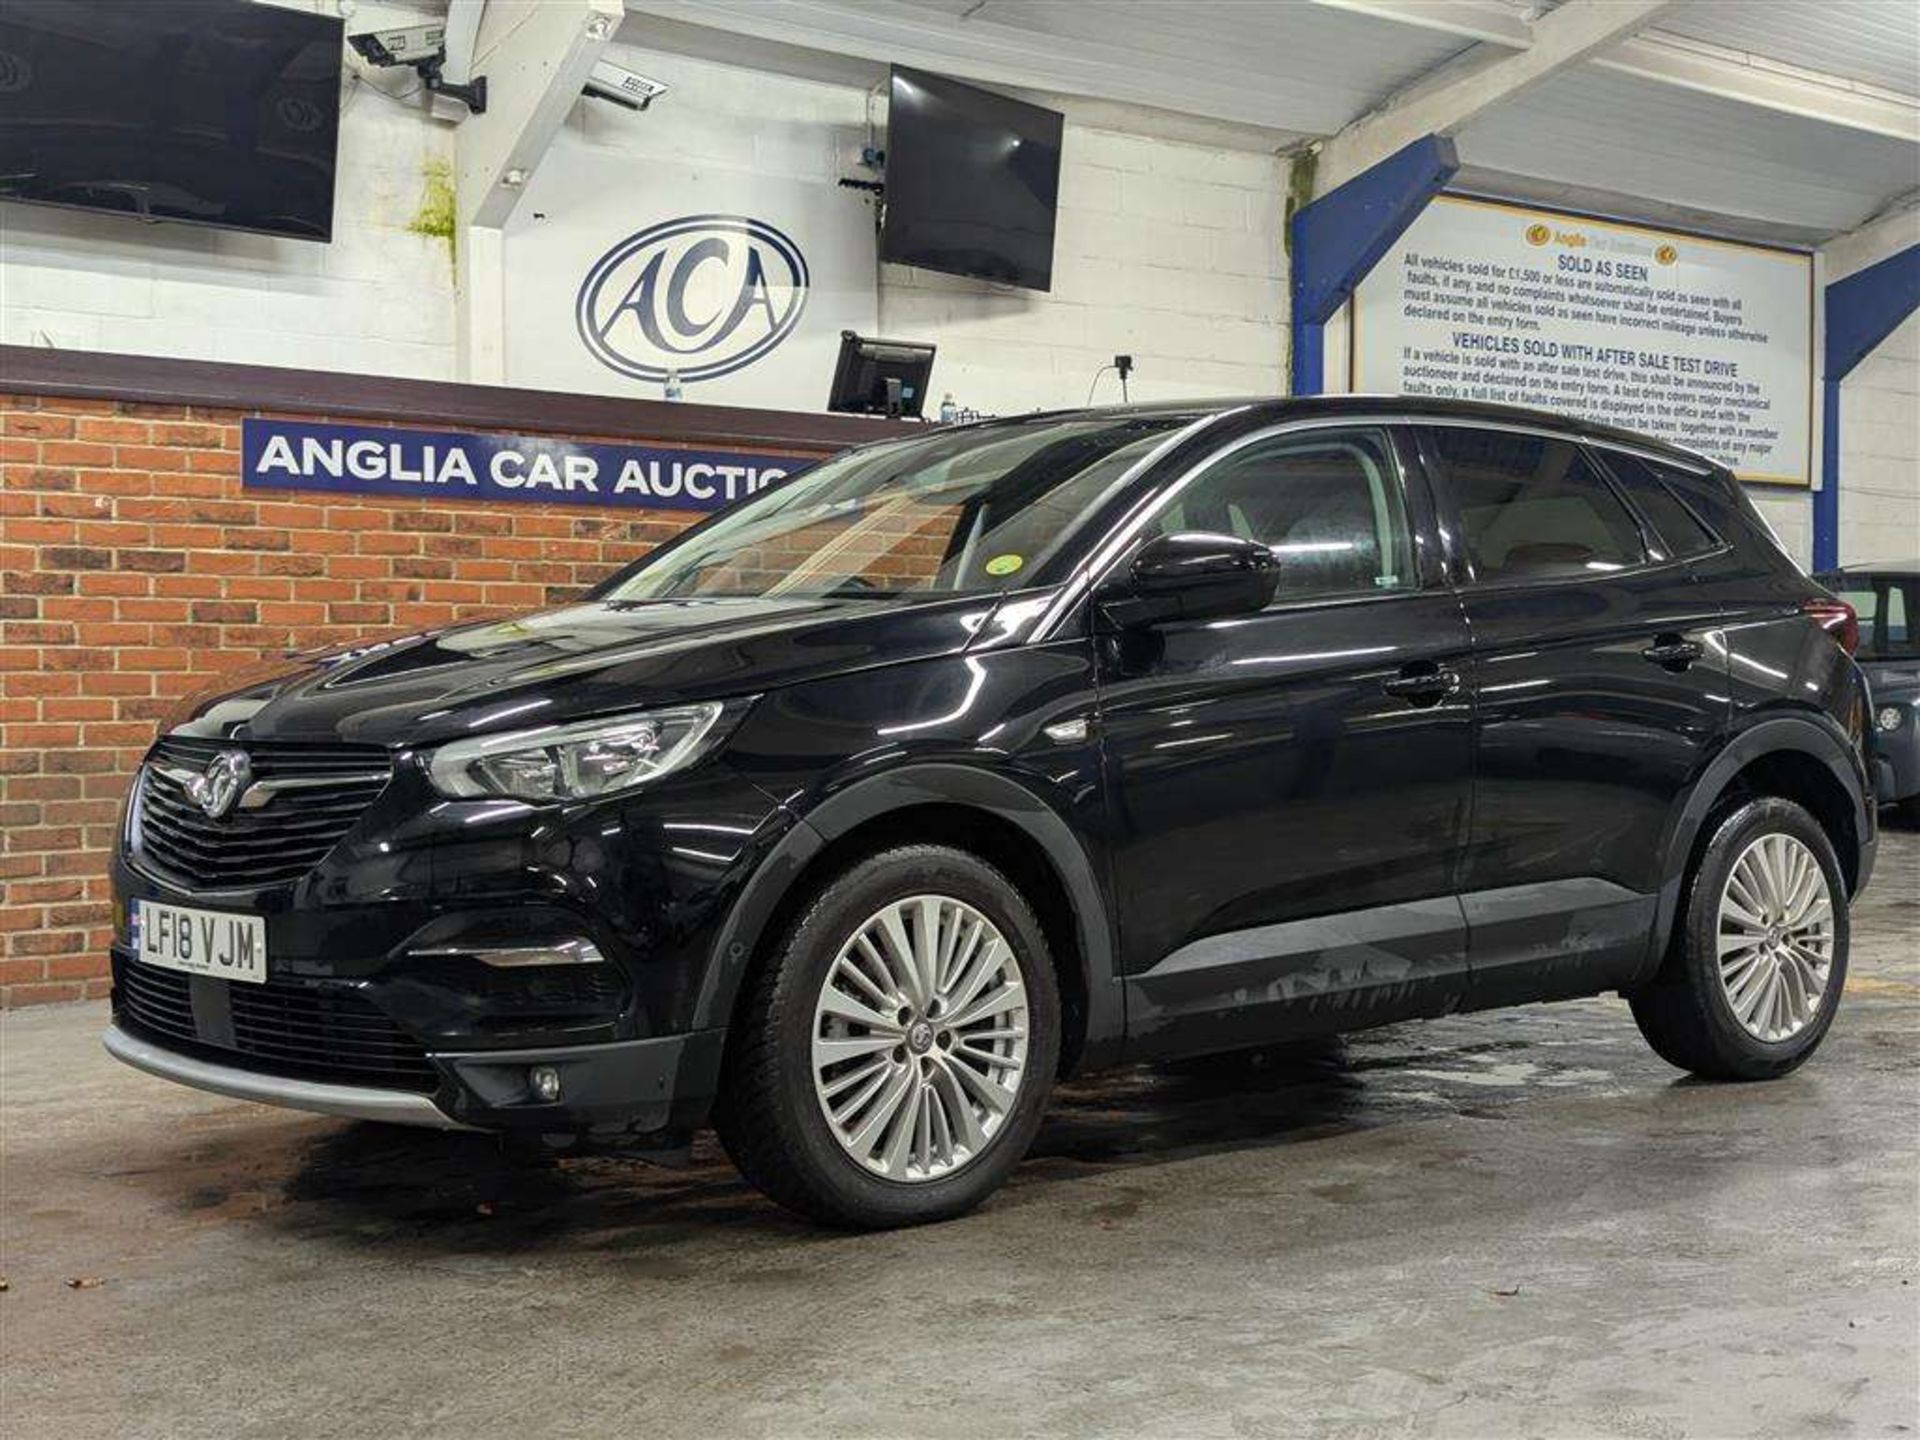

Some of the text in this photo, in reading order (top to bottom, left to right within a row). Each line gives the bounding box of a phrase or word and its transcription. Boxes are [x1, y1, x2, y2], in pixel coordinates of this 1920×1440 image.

[1404, 253, 1418, 267] All
[1421, 256, 1464, 273] vehicles
[1467, 263, 1489, 277] sold
[1491, 265, 1506, 278] for
[1543, 274, 1552, 284] or
[1555, 273, 1574, 288] less
[1577, 279, 1592, 290] are
[1595, 281, 1654, 299] automatically
[1656, 289, 1675, 302] sold
[1678, 293, 1688, 302] as
[1690, 295, 1710, 306] seen
[1712, 298, 1729, 309] with
[1732, 299, 1742, 311] all
[1558, 254, 1648, 281] SOLD AS SEEN
[599, 237, 777, 355] ACA
[1404, 289, 1768, 344] must assume all vehicles sold as seen have incorrect mileage unless otherwise
[1404, 304, 1449, 320] declared
[1452, 311, 1465, 322] on
[1468, 311, 1484, 324] the
[1487, 315, 1514, 331] entry
[1443, 274, 1450, 287] if
[1477, 281, 1495, 294] and
[1498, 284, 1511, 295] no
[1513, 285, 1565, 302] complaints
[1568, 292, 1621, 310] whatsoever
[1623, 299, 1644, 313] shall
[1646, 302, 1658, 314] be
[1713, 310, 1742, 326] Buyers
[1404, 347, 1411, 359] If
[1414, 351, 1420, 360] a
[1423, 349, 1459, 364] vehicle
[1462, 354, 1472, 366] is
[1474, 356, 1497, 368] sold
[1500, 357, 1520, 371] with
[1523, 361, 1535, 371] an
[1537, 361, 1558, 374] after
[1561, 364, 1580, 376] sale
[1583, 365, 1600, 378] test
[1631, 370, 1647, 383] this
[1650, 373, 1671, 386] shall
[1673, 375, 1684, 387] be
[1687, 377, 1732, 393] announced
[1735, 382, 1744, 394] by
[1747, 383, 1760, 394] the
[1452, 332, 1738, 377] VEHICLES SOLD WITH AFTER SALE TEST DRIVE
[1404, 365, 1458, 381] auctioneer
[1461, 370, 1480, 383] and
[1482, 372, 1527, 387] declared
[1529, 378, 1541, 388] on
[1544, 378, 1559, 390] the
[1561, 380, 1584, 395] entry
[1614, 385, 1620, 396] A
[1623, 386, 1641, 398] test
[1642, 387, 1664, 401] drive
[1667, 391, 1696, 403] covers
[1699, 393, 1722, 406] major
[1724, 395, 1770, 410] mechanical
[1404, 381, 1432, 395] faults
[1462, 388, 1469, 397] a
[1472, 386, 1487, 399] full
[1490, 388, 1506, 401] list
[1508, 391, 1519, 402] of
[1521, 392, 1548, 406] faults
[1550, 395, 1587, 409] covered
[1590, 398, 1599, 409] is
[1601, 399, 1644, 414] displayed
[1646, 403, 1655, 415] in
[1657, 404, 1671, 416] the
[1674, 405, 1698, 418] office
[1701, 409, 1716, 420] and
[1718, 410, 1736, 421] with
[1738, 411, 1751, 423] the
[1613, 417, 1636, 428] must
[1639, 419, 1649, 429] be
[1681, 422, 1717, 436] together
[1719, 426, 1736, 437] with
[1745, 428, 1779, 439] member
[257, 436, 477, 485] ANGLIA
[490, 451, 599, 492] CAR
[146, 907, 254, 970] LF18 VJM
